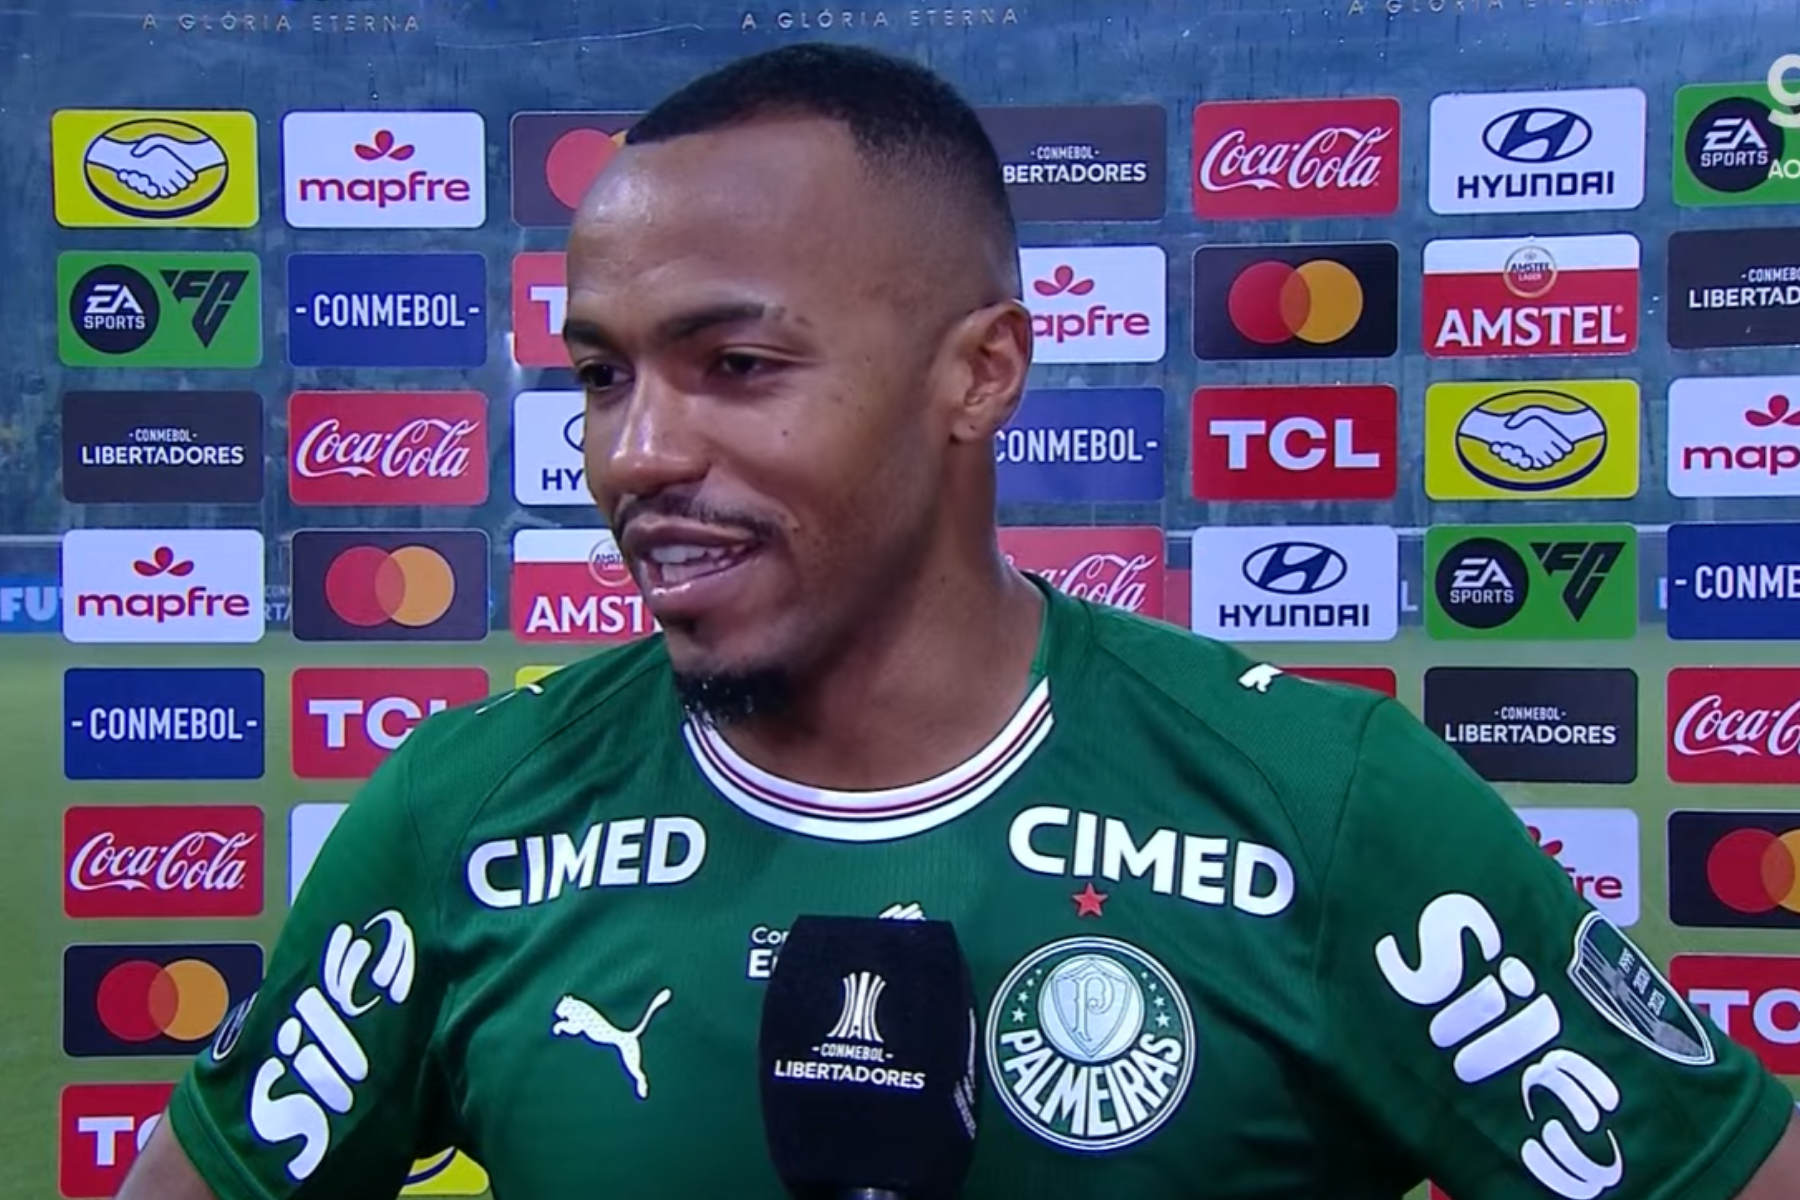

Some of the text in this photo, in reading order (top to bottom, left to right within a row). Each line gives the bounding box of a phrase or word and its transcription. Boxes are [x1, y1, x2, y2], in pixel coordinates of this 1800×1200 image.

[142, 11, 419, 32] A GLÓRIA ETERNA
[742, 8, 1018, 30] A GLÓRIA ETERNA
[1703, 118, 1767, 150] EA
[1199, 126, 1393, 193] Coca-Cola
[1700, 151, 1768, 167] SPORTS
[299, 171, 470, 208] mapfre
[1458, 170, 1615, 199] HYUNDAI
[87, 284, 143, 313] EA
[84, 314, 145, 330] SPORTS
[1434, 305, 1627, 348] AMSTEL
[81, 446, 244, 465] LIBERTADORES
[297, 419, 479, 478] Coca-Cola
[1210, 417, 1380, 470] TCL
[1451, 557, 1512, 588] EA
[77, 586, 249, 623] mapfre
[1449, 588, 1514, 605] SPORTS
[526, 596, 664, 633] AMST
[1218, 604, 1370, 628] HYUNDAI
[309, 696, 447, 750] TC
[1444, 722, 1616, 744] LIBERTADORES
[70, 832, 258, 892] Coca-Cola
[467, 815, 706, 909] CIMED
[1009, 806, 1295, 916] CIMED
[774, 1059, 926, 1089] LIBERTADORES
[1000, 1028, 1181, 1137] PALMEIRAS
